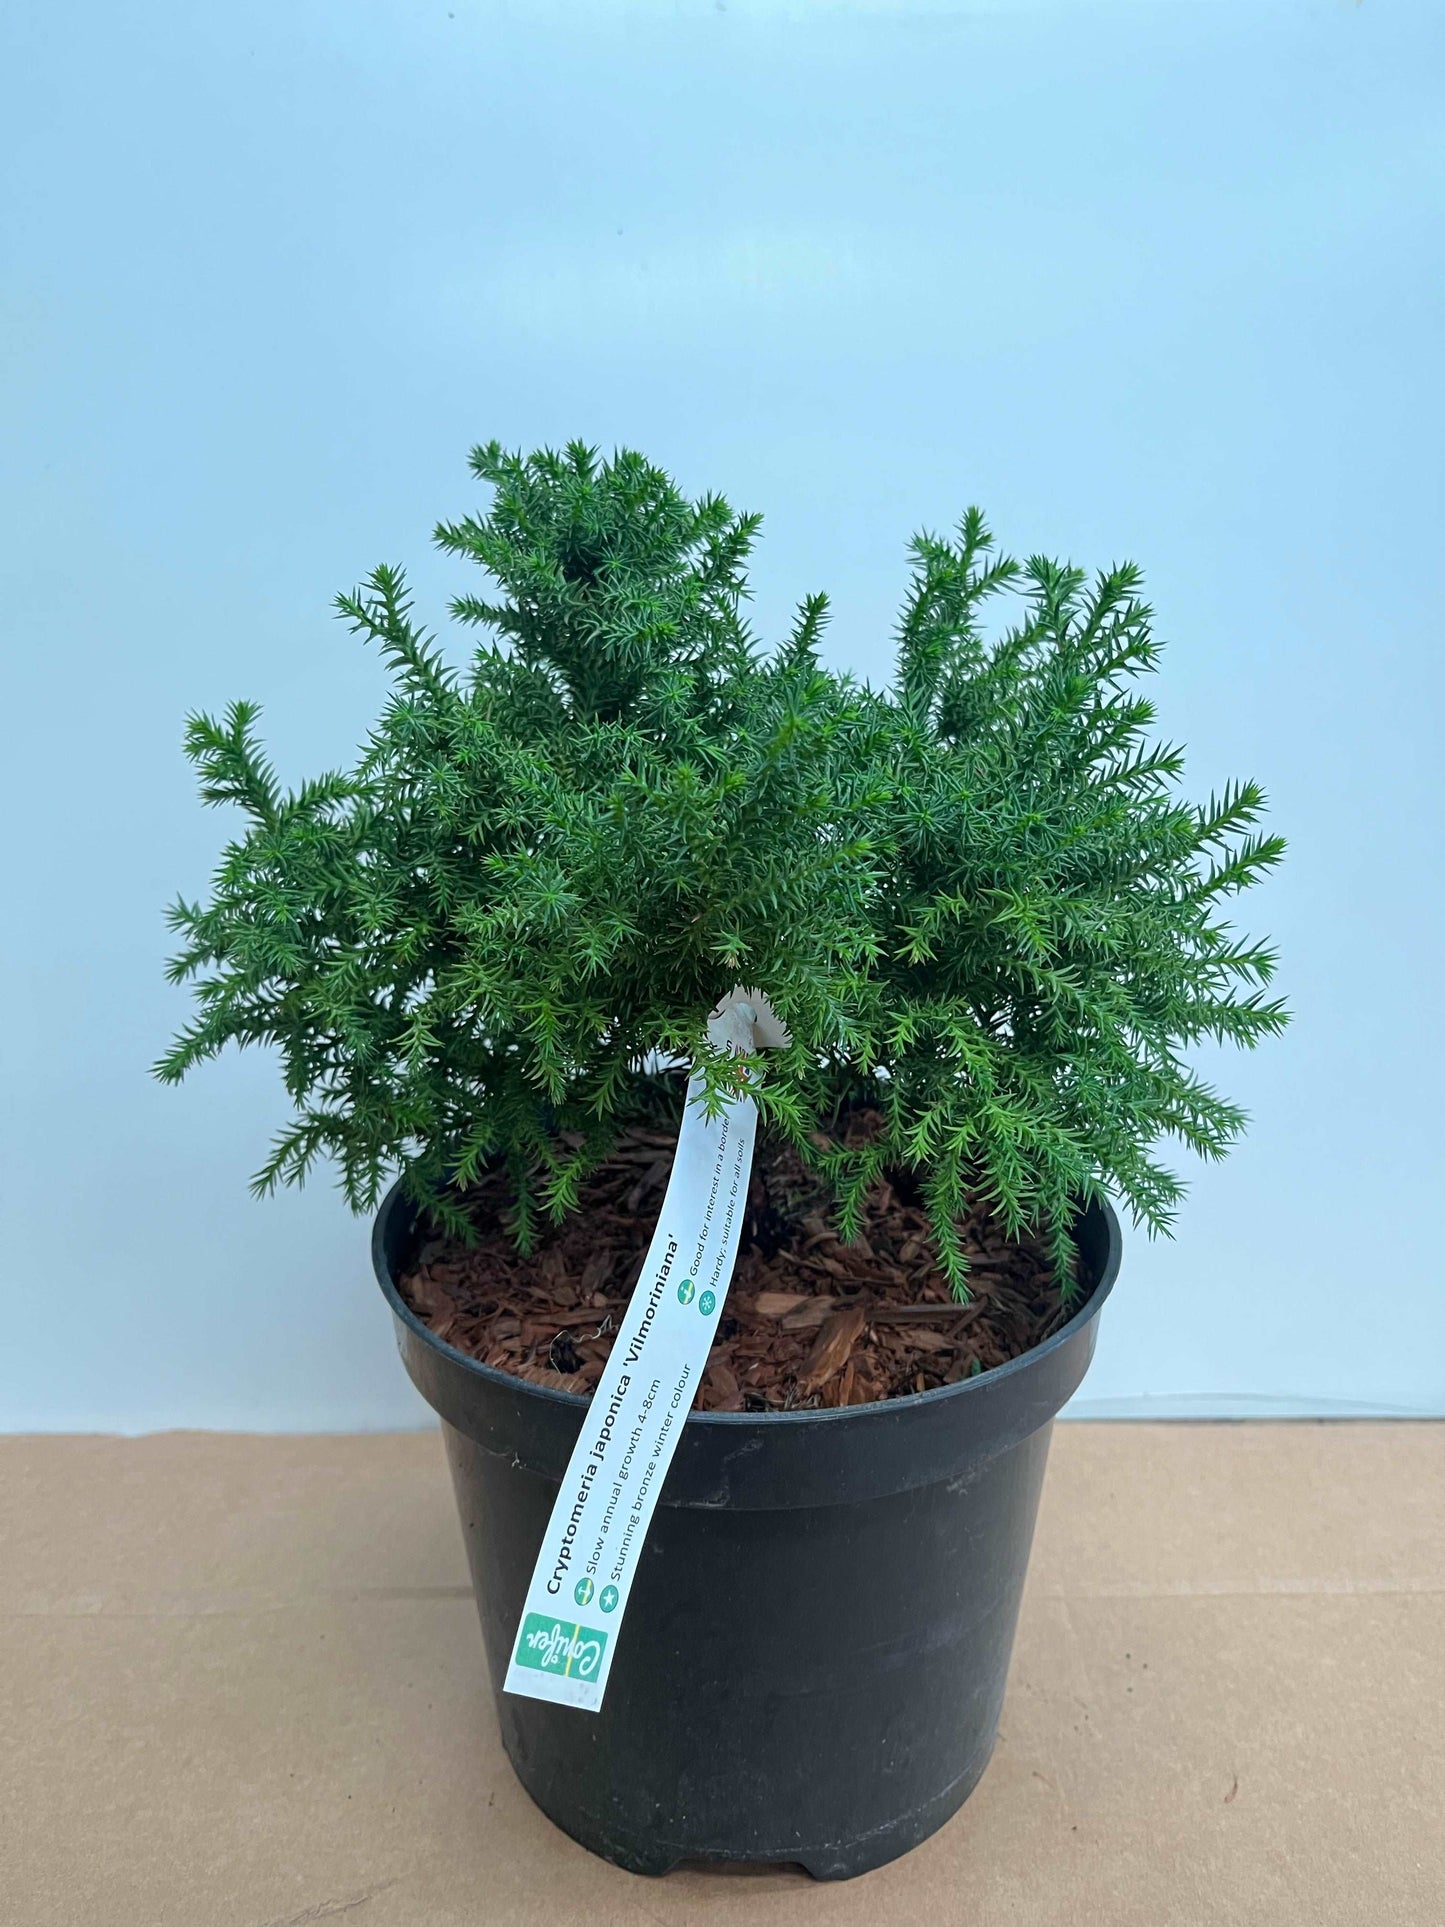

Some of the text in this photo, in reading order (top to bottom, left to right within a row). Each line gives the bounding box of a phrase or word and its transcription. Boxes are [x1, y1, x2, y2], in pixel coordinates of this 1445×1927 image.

[689, 1118, 730, 1276] Good for interest in a borde
[709, 1247, 727, 1287] Hardy;
[721, 1199, 735, 1245] suitable
[729, 1179, 739, 1197] for
[737, 1138, 745, 1163] soils
[546, 1233, 678, 1595] Cryptomeria japonica 'Vilmoriniana'
[586, 1379, 661, 1575] Slow annual growth 4-8cm
[610, 1363, 691, 1581] Stunning bronze winter colour
[526, 1623, 601, 1675] Conifer
